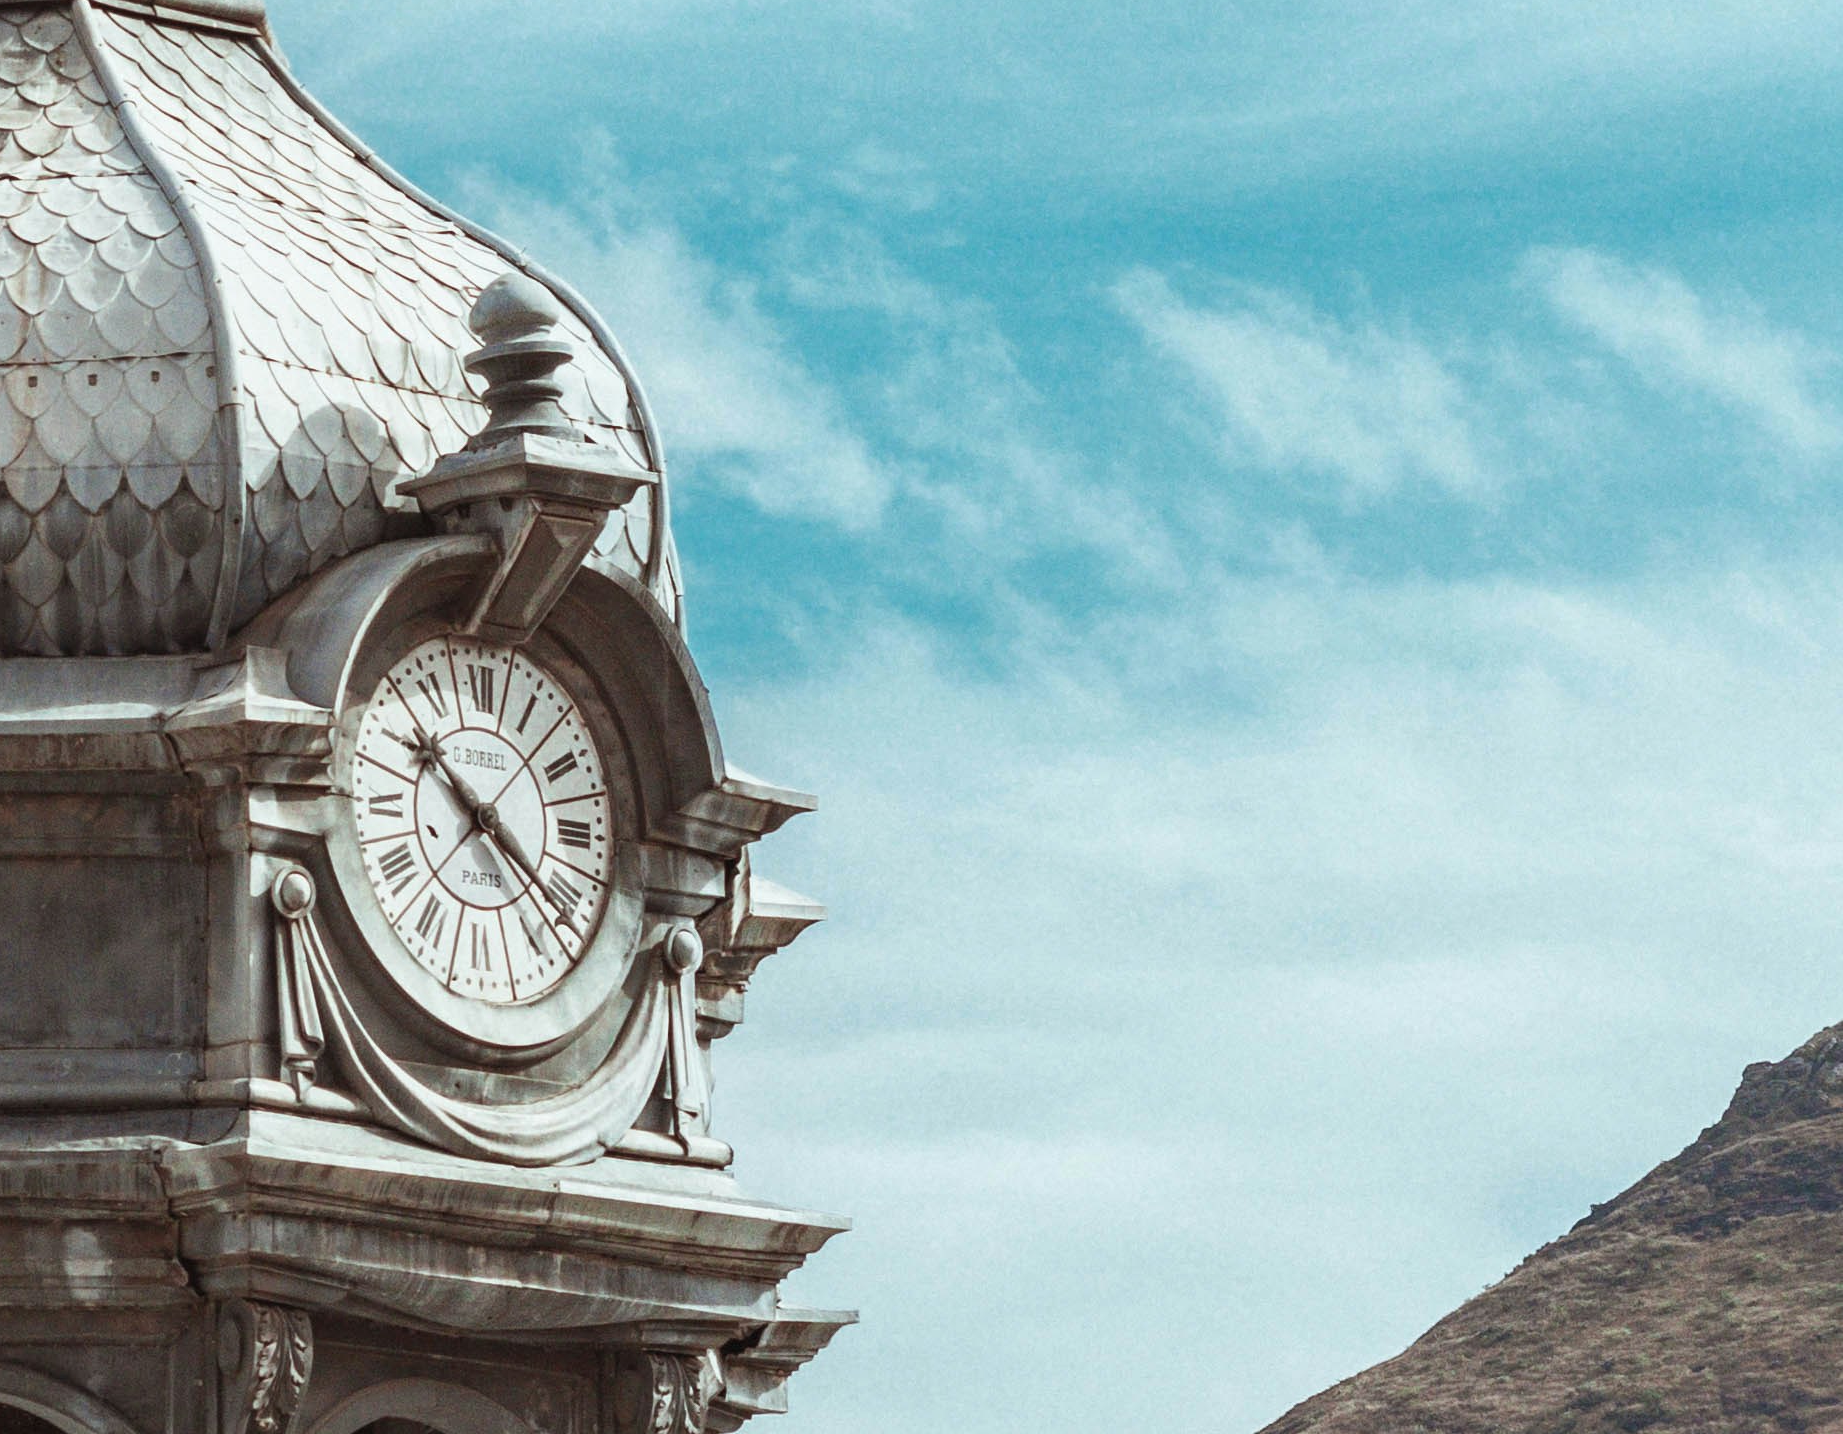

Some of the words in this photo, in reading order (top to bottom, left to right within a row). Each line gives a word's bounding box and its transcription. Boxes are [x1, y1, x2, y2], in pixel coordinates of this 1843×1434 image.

[416, 671, 449, 724] XI
[466, 664, 494, 715] XII
[516, 692, 539, 735] I
[544, 749, 579, 784] II
[369, 786, 404, 818] IX
[557, 817, 591, 850] III
[378, 841, 420, 898] VIII
[462, 869, 502, 888] PARIS
[415, 892, 448, 950] VII
[470, 921, 492, 972] VI
